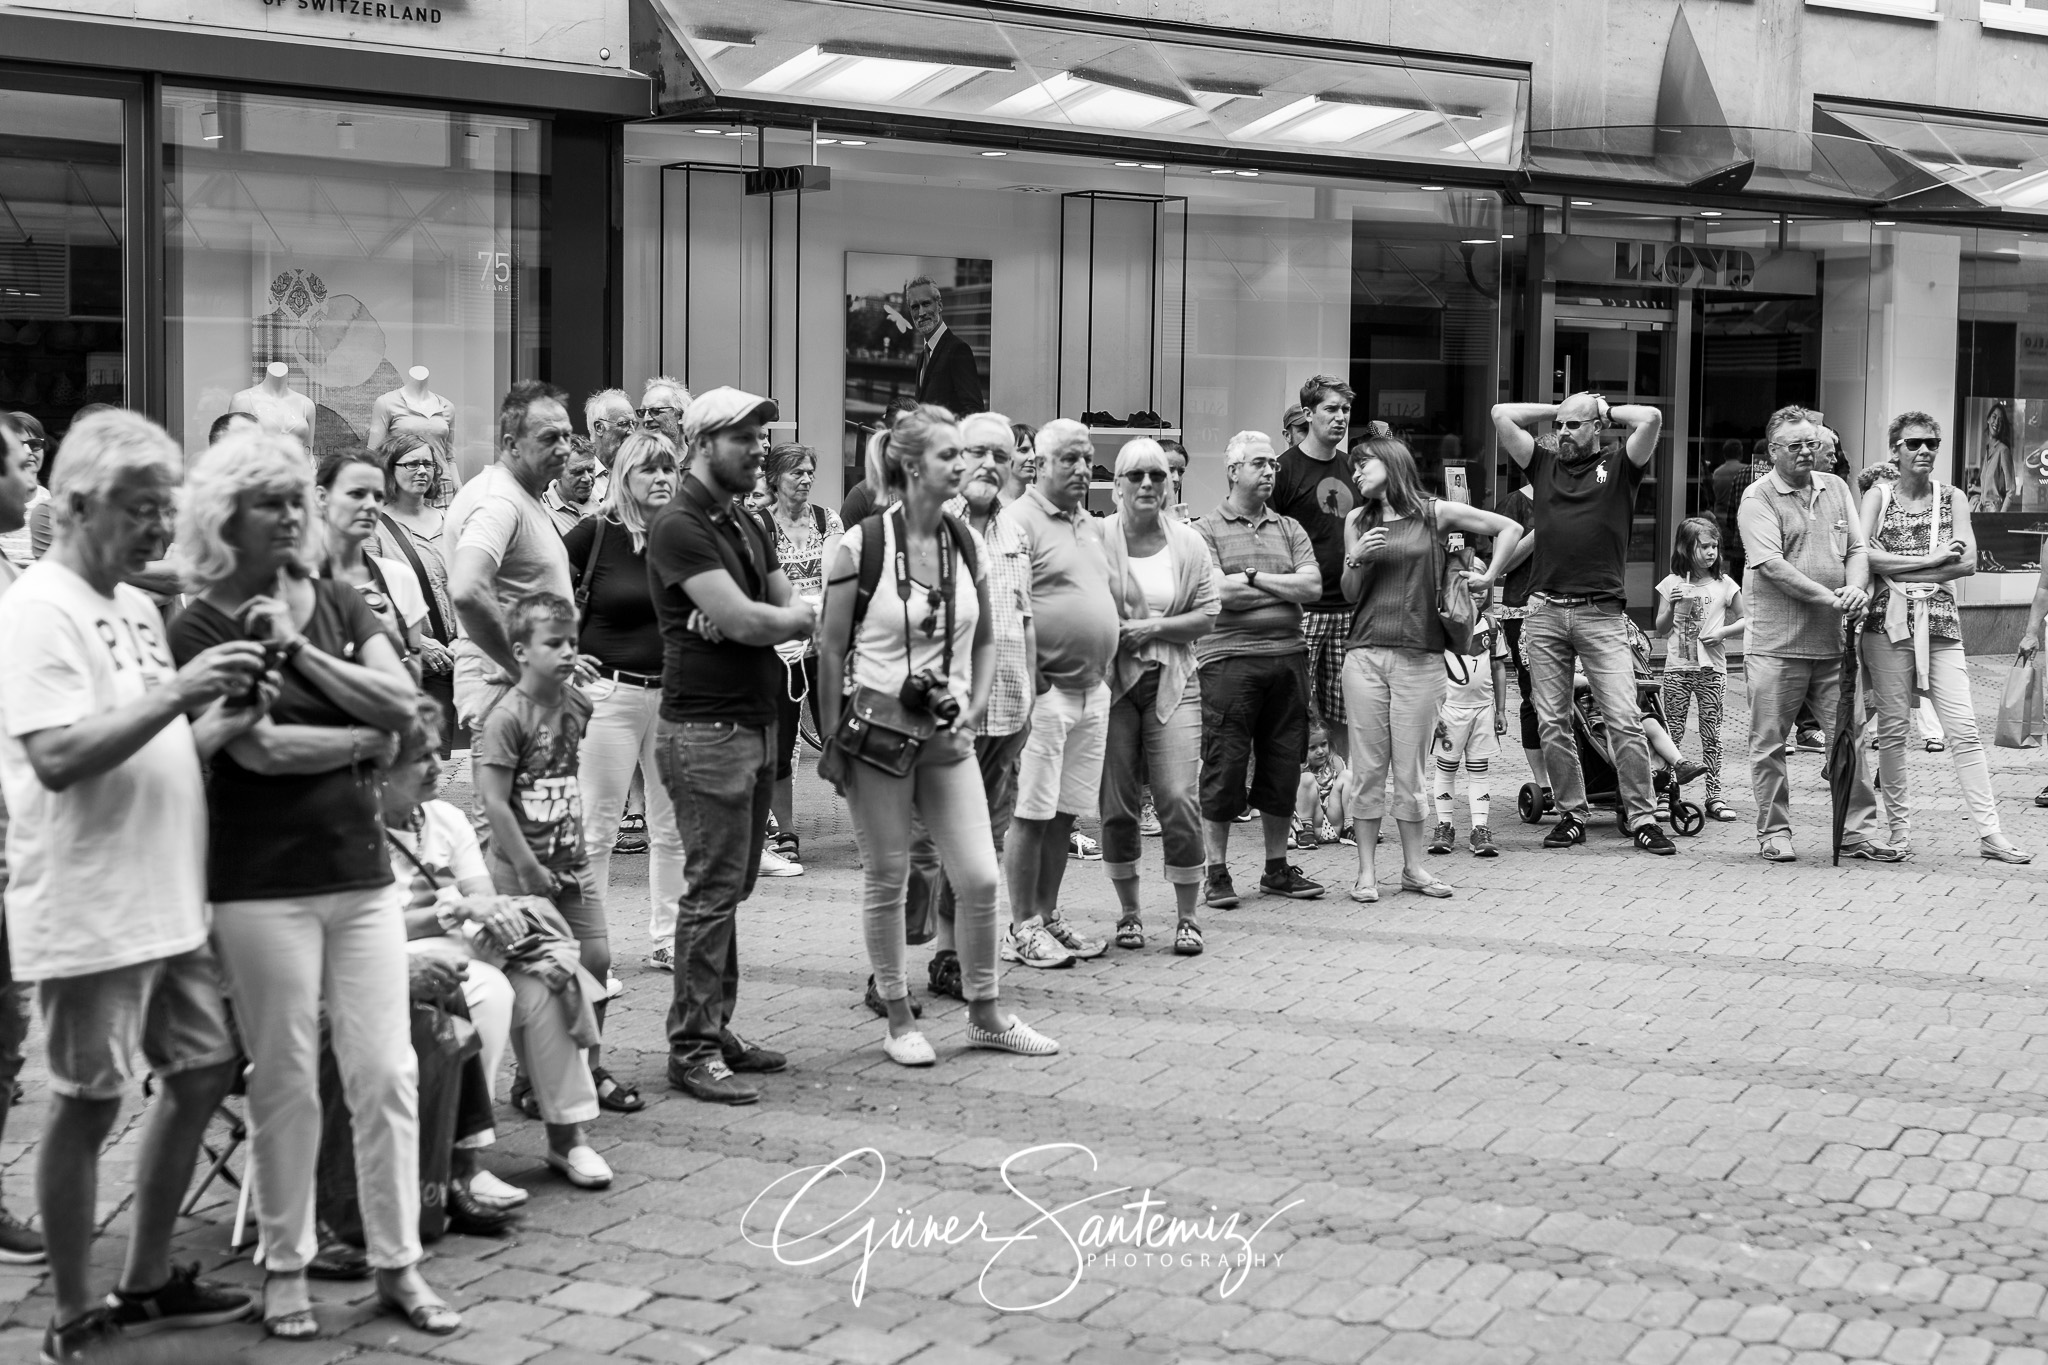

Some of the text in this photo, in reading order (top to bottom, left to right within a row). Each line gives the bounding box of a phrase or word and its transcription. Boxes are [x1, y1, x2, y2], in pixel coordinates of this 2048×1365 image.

[298, 0, 441, 24] SWITZERLAND
[478, 251, 510, 283] 75
[1613, 241, 1755, 288] LLOYD
[480, 284, 509, 292] YEARS
[1472, 659, 1478, 673] 7
[521, 776, 578, 800] STA
